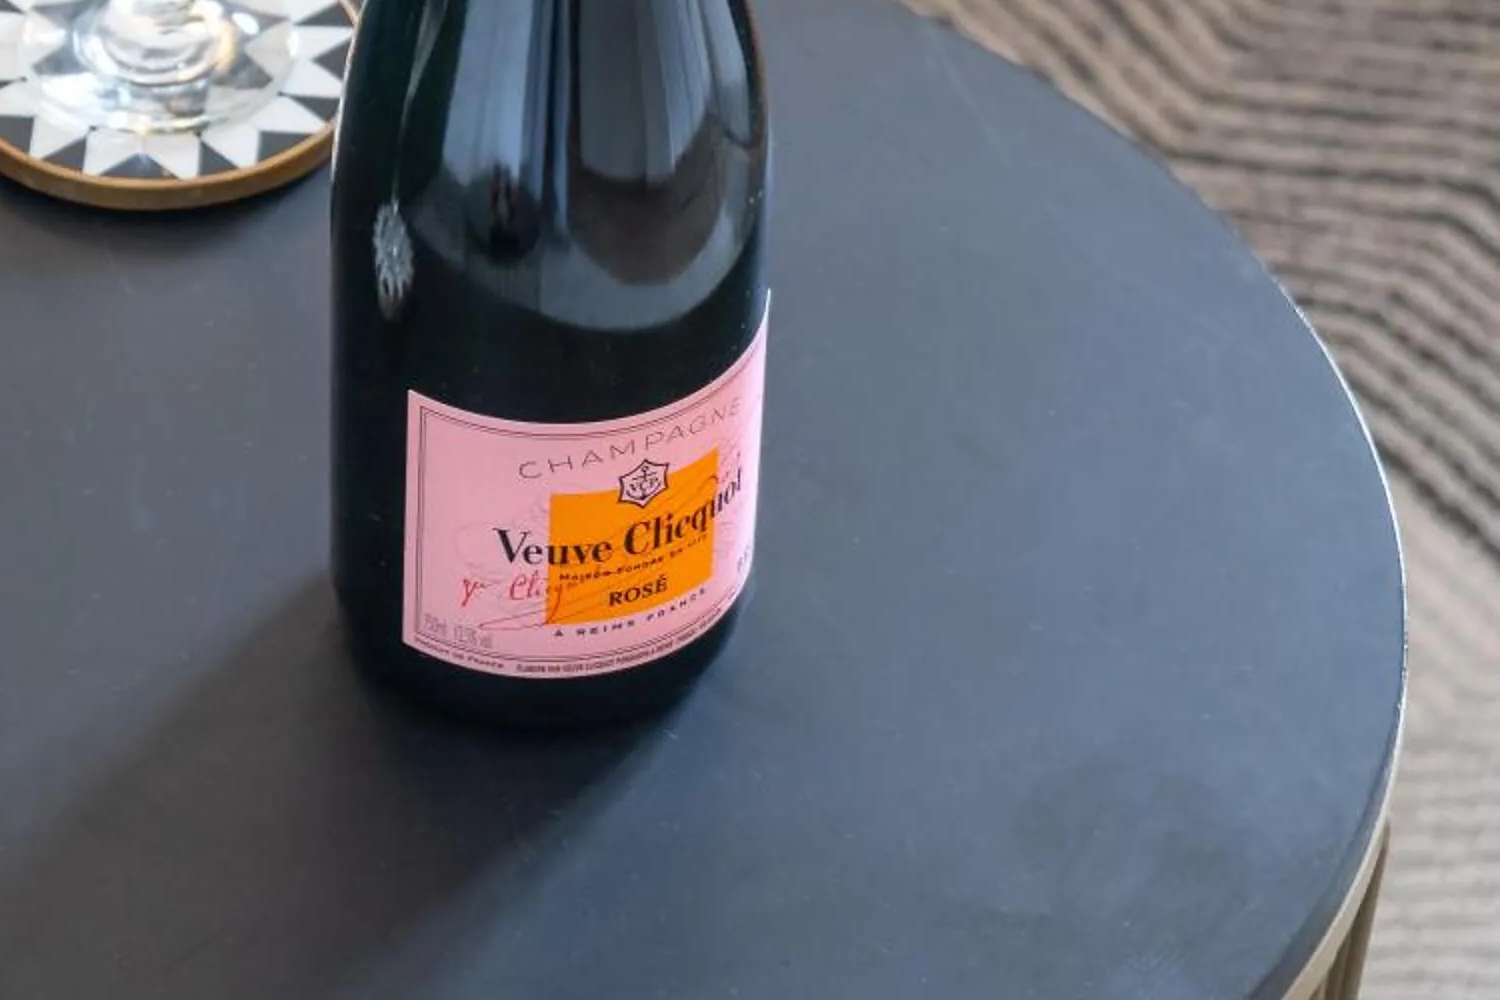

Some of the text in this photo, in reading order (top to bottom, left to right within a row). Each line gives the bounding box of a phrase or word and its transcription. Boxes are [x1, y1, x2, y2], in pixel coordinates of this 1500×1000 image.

[518, 396, 741, 480] CHAMPAGNE
[492, 466, 742, 566] Veuve Clicquot
[608, 572, 669, 607] ROSÉ
